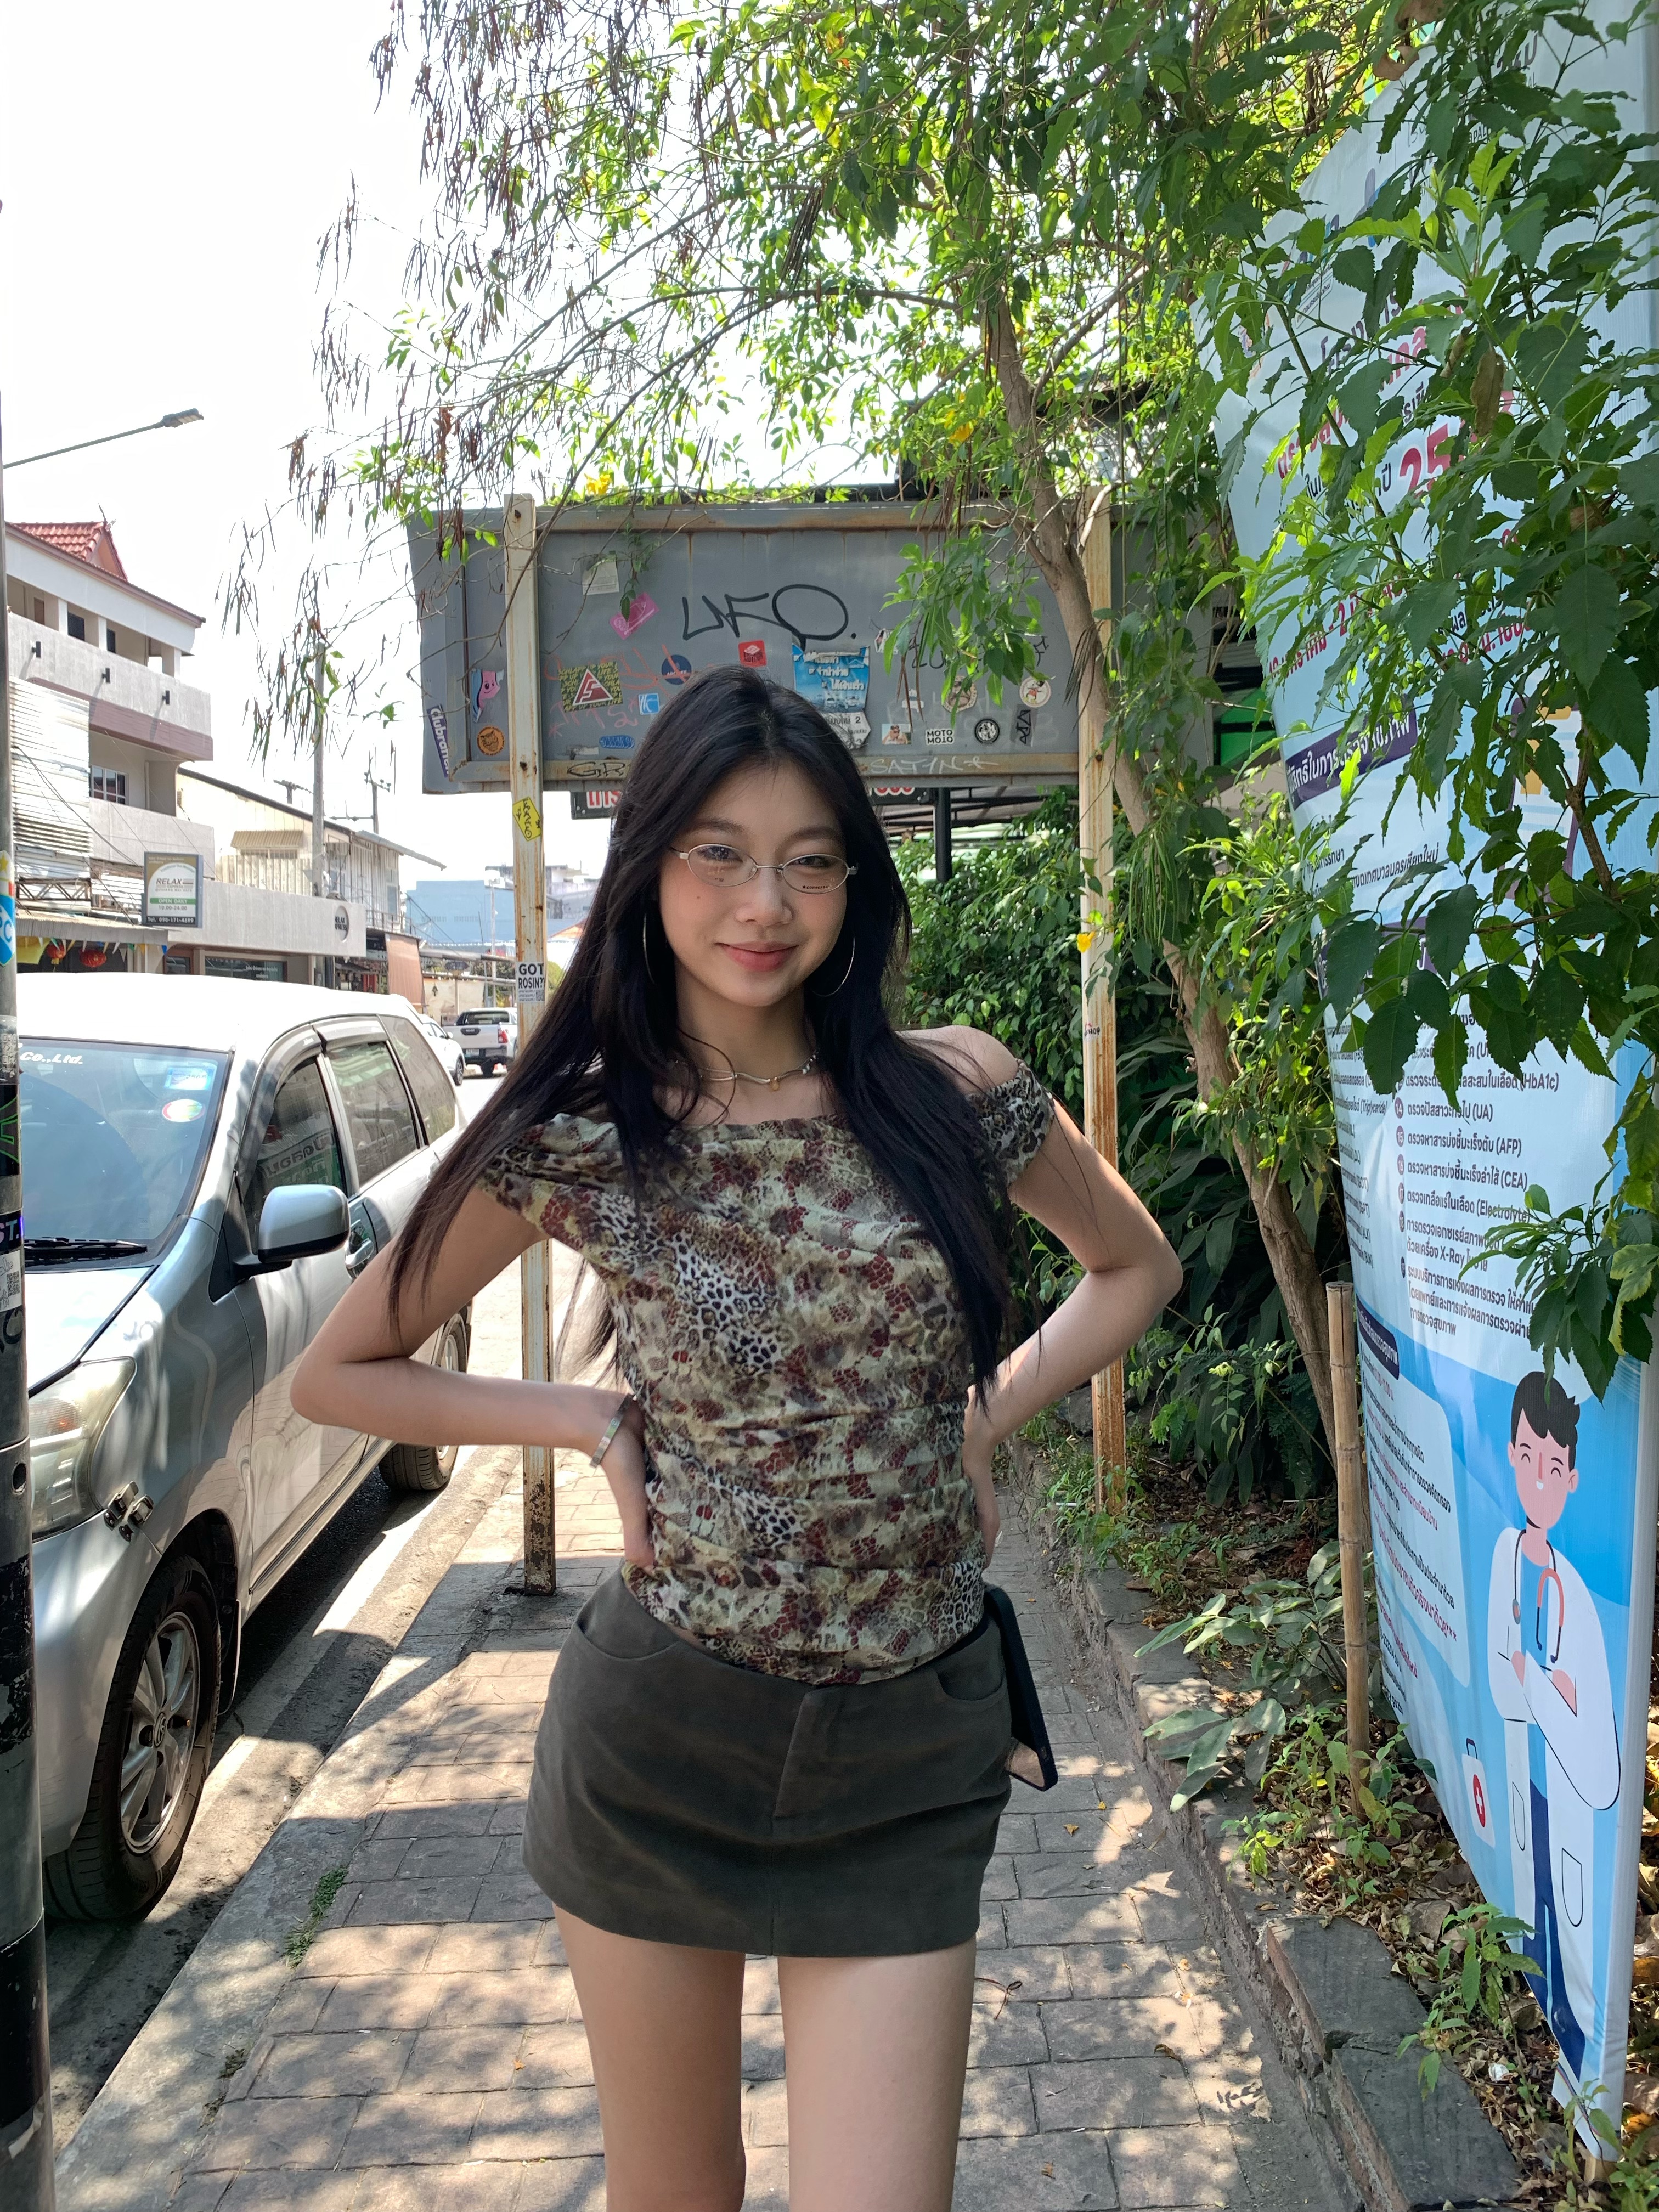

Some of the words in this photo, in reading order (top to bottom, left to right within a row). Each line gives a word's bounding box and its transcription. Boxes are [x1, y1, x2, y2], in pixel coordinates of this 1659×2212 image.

[519, 963, 544, 975] GOT
[1472, 1103, 1493, 1122] (UA)
[1496, 1136, 1522, 1158] (AFP)
[1501, 1170, 1528, 1192] (CEA)
[1440, 1245, 1465, 1268] X-Ray
